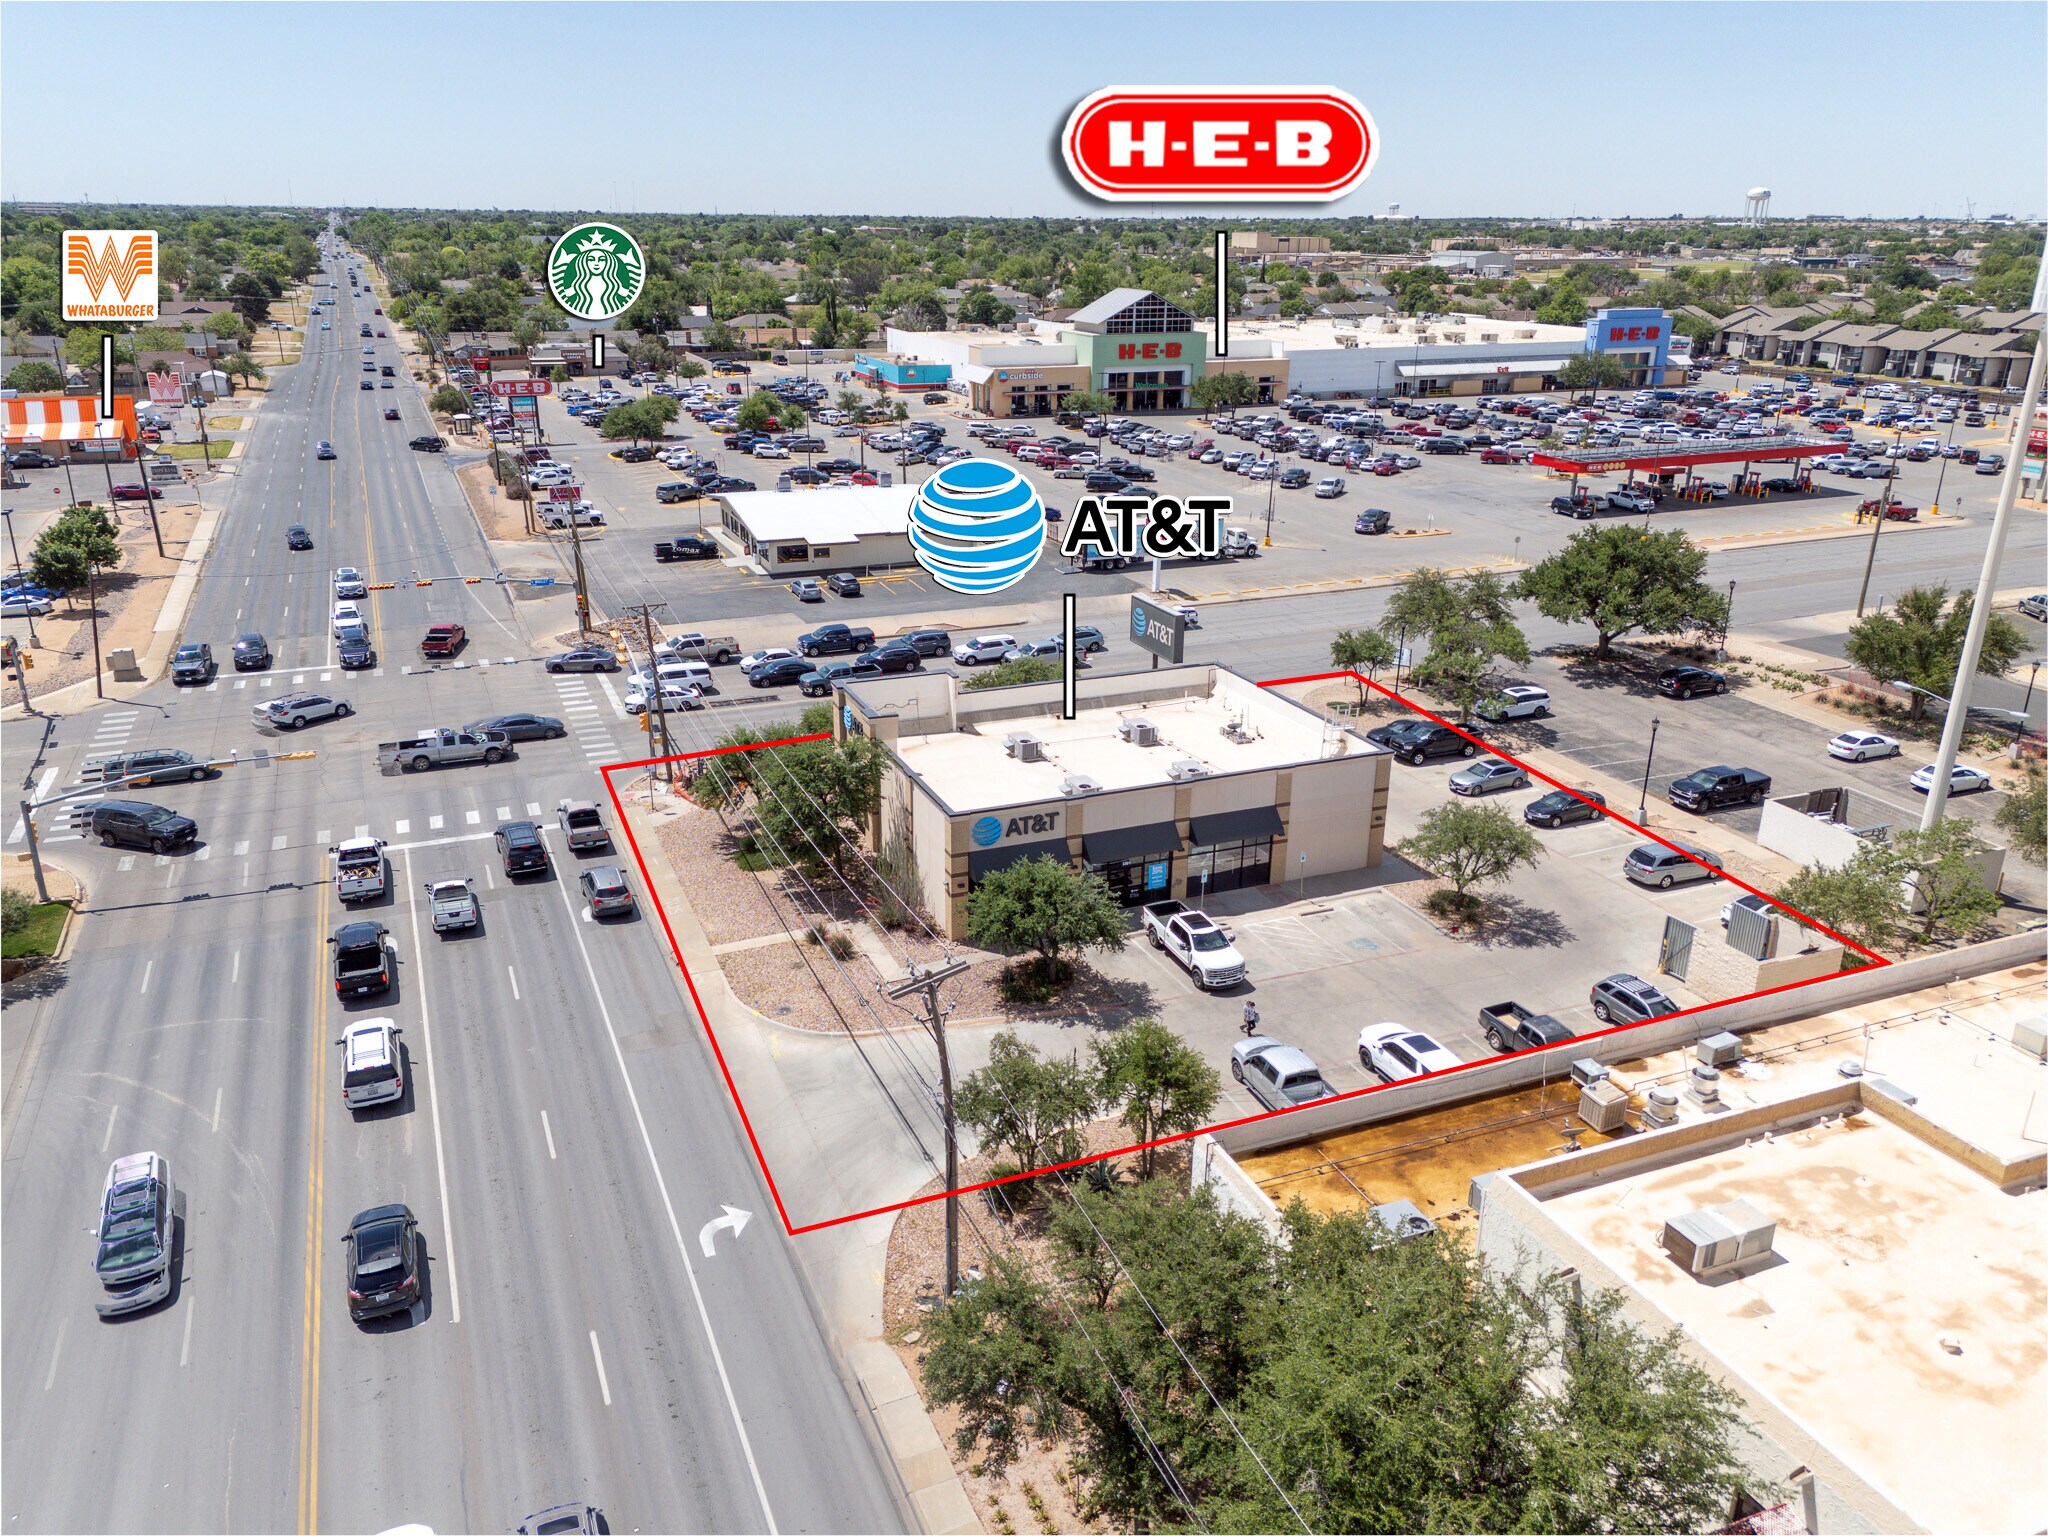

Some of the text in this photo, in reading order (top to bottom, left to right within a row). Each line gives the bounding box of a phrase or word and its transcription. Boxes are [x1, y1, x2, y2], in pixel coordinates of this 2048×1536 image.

[1609, 326, 1660, 341] H-E-B
[1118, 342, 1183, 360] H-E-B
[1009, 372, 1043, 380] curbside
[498, 383, 545, 394] H-E-B
[1147, 619, 1174, 647] AT&T
[1005, 811, 1060, 838] AT&T
